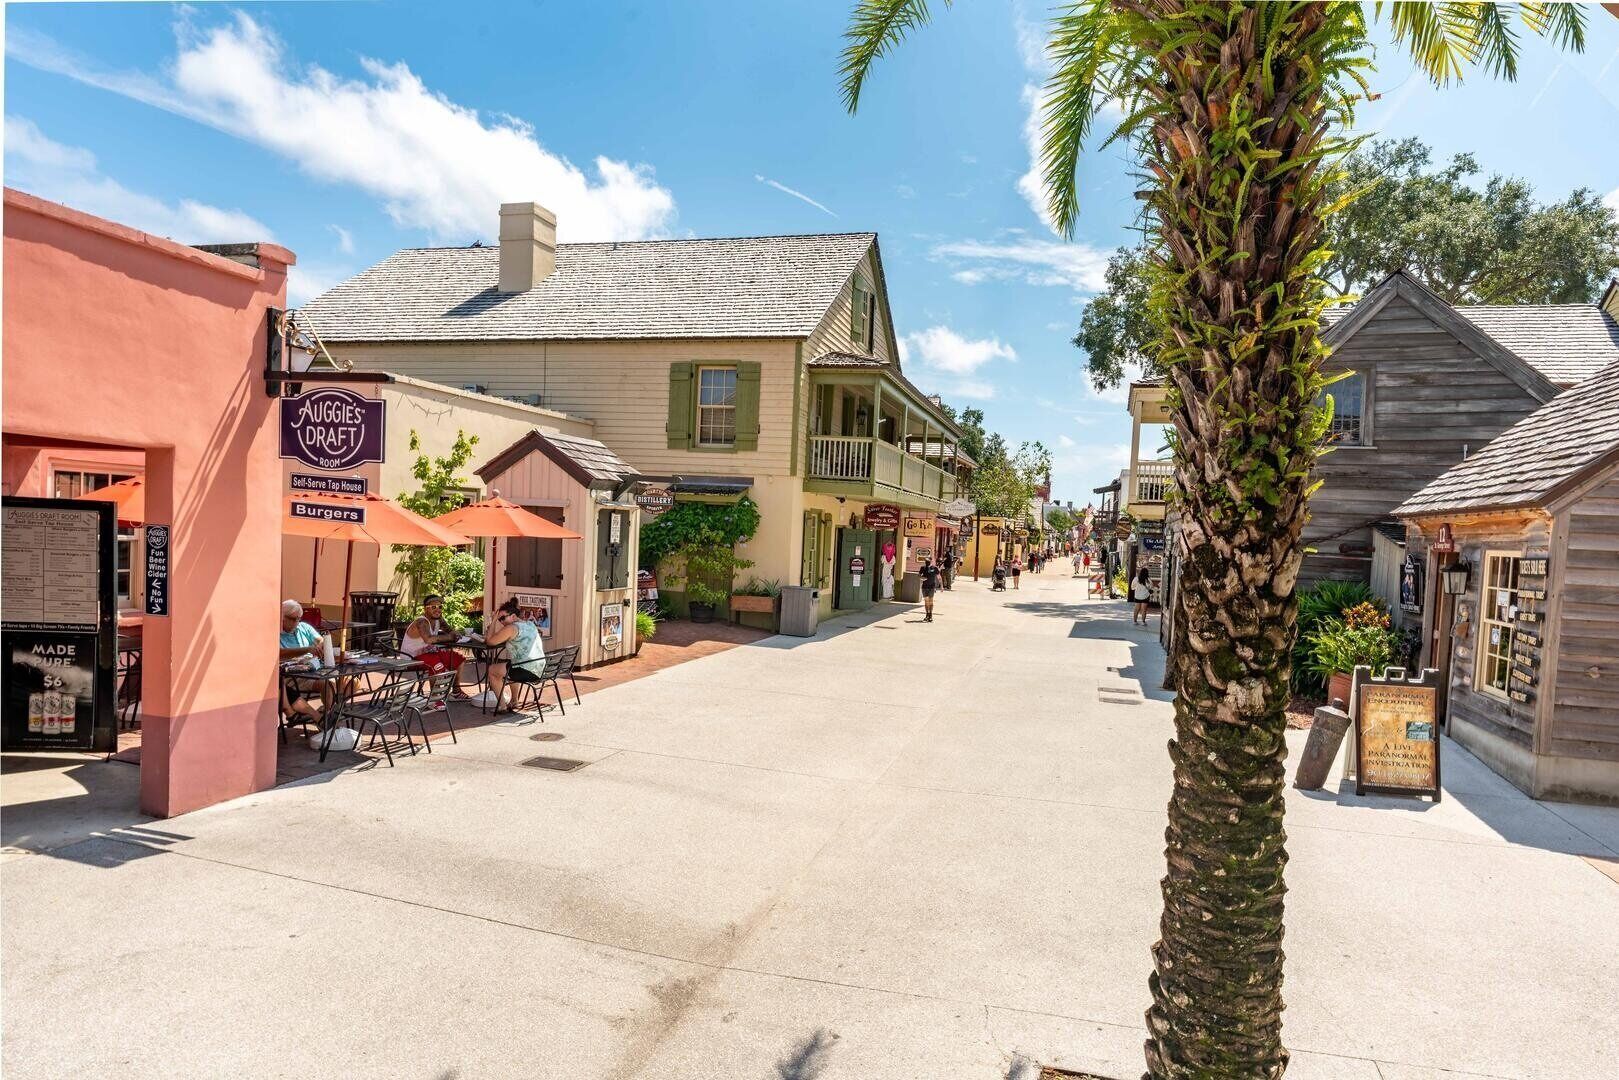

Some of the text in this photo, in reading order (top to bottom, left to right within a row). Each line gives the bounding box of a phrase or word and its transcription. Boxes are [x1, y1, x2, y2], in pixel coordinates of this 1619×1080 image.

[306, 425, 358, 454] DRAFT
[319, 457, 341, 468] ROOM
[292, 476, 362, 492] Self-Serve Tap House
[637, 496, 672, 504] DISTILLERY
[296, 504, 358, 520] Burgers
[907, 520, 918, 530] Go
[150, 549, 164, 557] Fun
[148, 556, 166, 564] Beer
[147, 570, 167, 578] Cider
[151, 589, 162, 597] No
[150, 596, 163, 604] Fun
[32, 644, 76, 655] MADE
[33, 657, 73, 668] PURE
[43, 674, 63, 688] $6
[1383, 743, 1412, 751] A LIVE
[1368, 750, 1430, 761] PARANORMAL
[1366, 759, 1431, 769] INVESTIGATION
